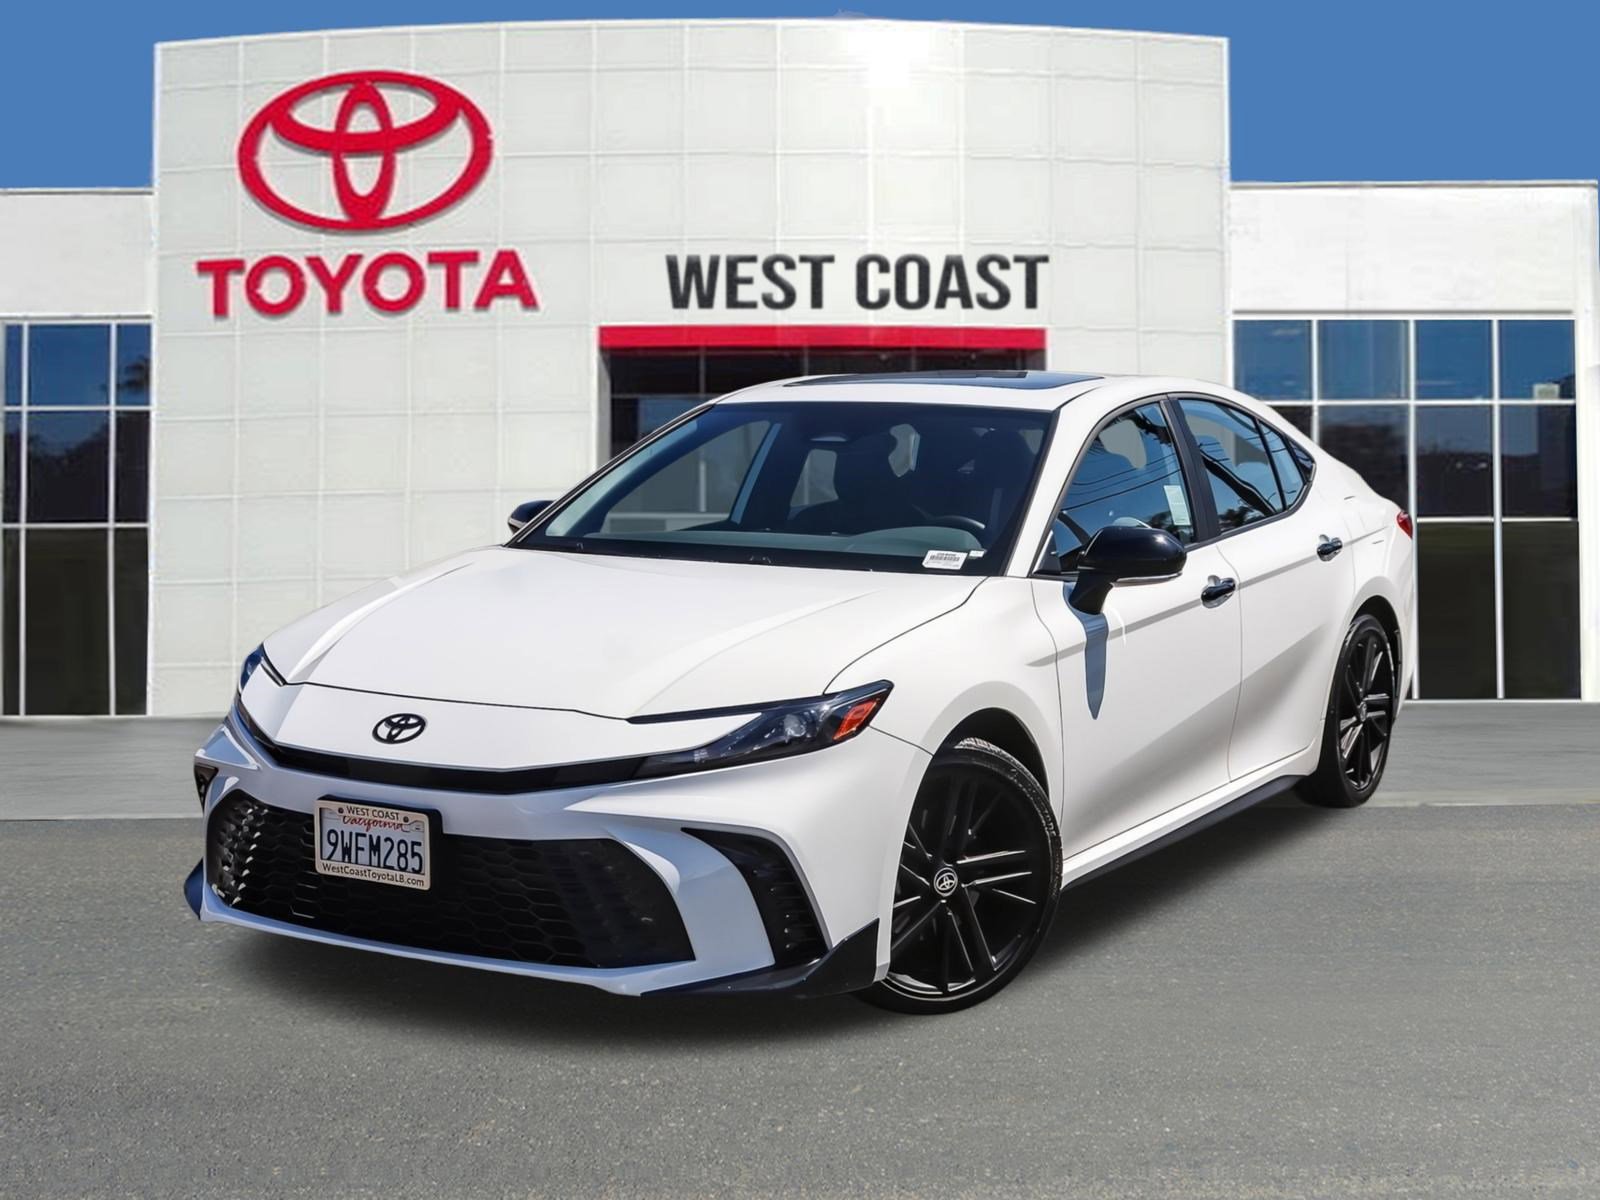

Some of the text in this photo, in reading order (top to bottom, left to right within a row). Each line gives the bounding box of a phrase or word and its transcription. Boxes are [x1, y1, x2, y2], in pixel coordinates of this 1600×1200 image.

[195, 249, 539, 317] TOYOTA
[667, 255, 1049, 310] WEST COAST
[346, 806, 400, 821] WEST COAST
[327, 829, 423, 873] 9WFM285
[322, 862, 424, 886] WestCoastToyotaLB.com
